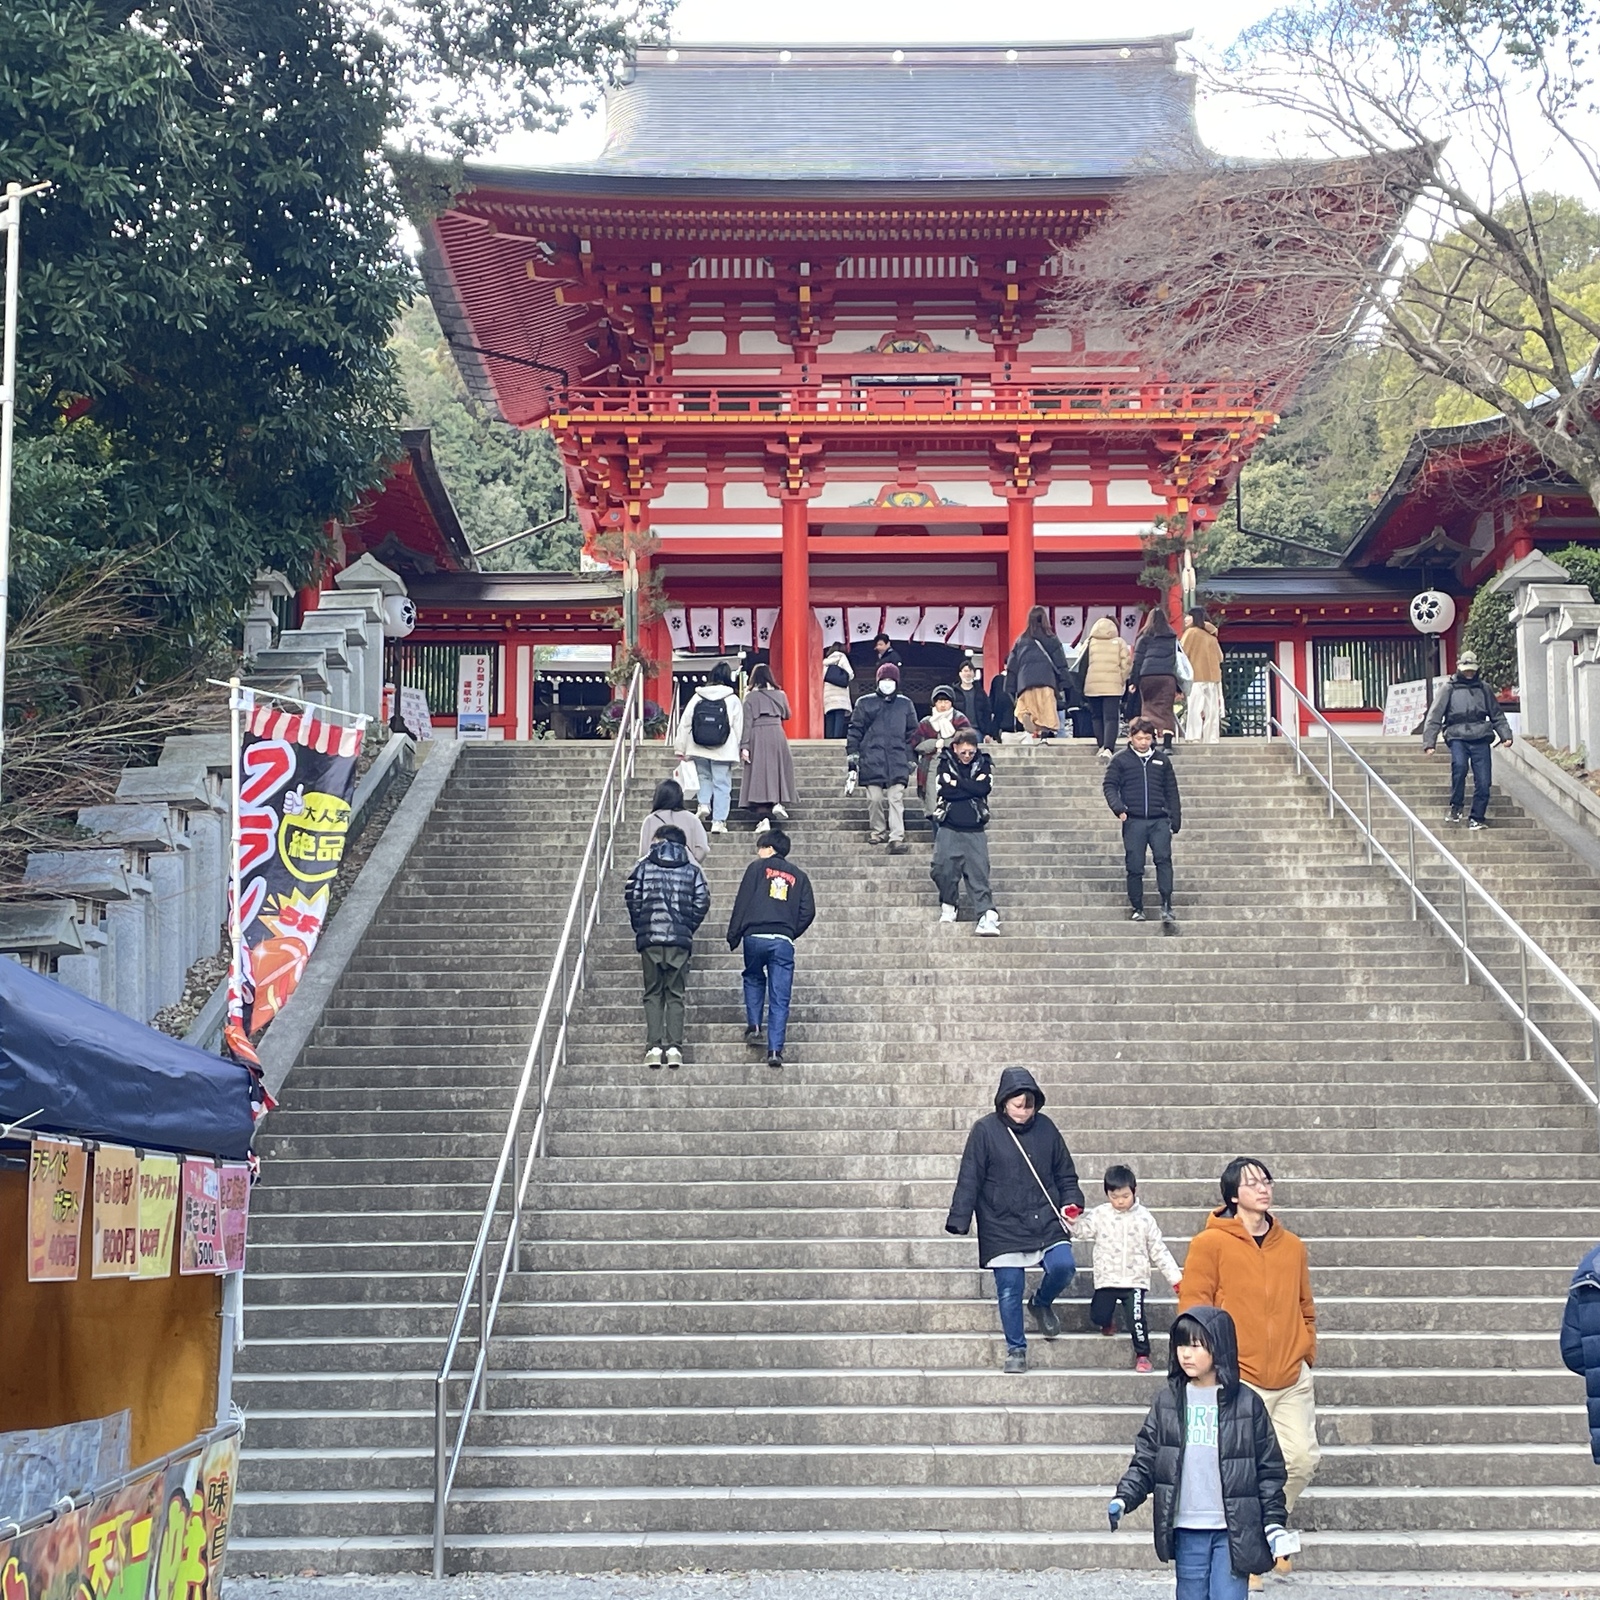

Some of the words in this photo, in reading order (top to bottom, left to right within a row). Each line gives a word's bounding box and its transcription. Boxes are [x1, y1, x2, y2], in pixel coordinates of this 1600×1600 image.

[287, 829, 346, 862] 絶品
[32, 1149, 69, 1185] フライド
[95, 1165, 134, 1206] からあげ
[52, 1188, 79, 1223] ポテト
[199, 1241, 214, 1266] 500
[1134, 1322, 1145, 1342] CAR
